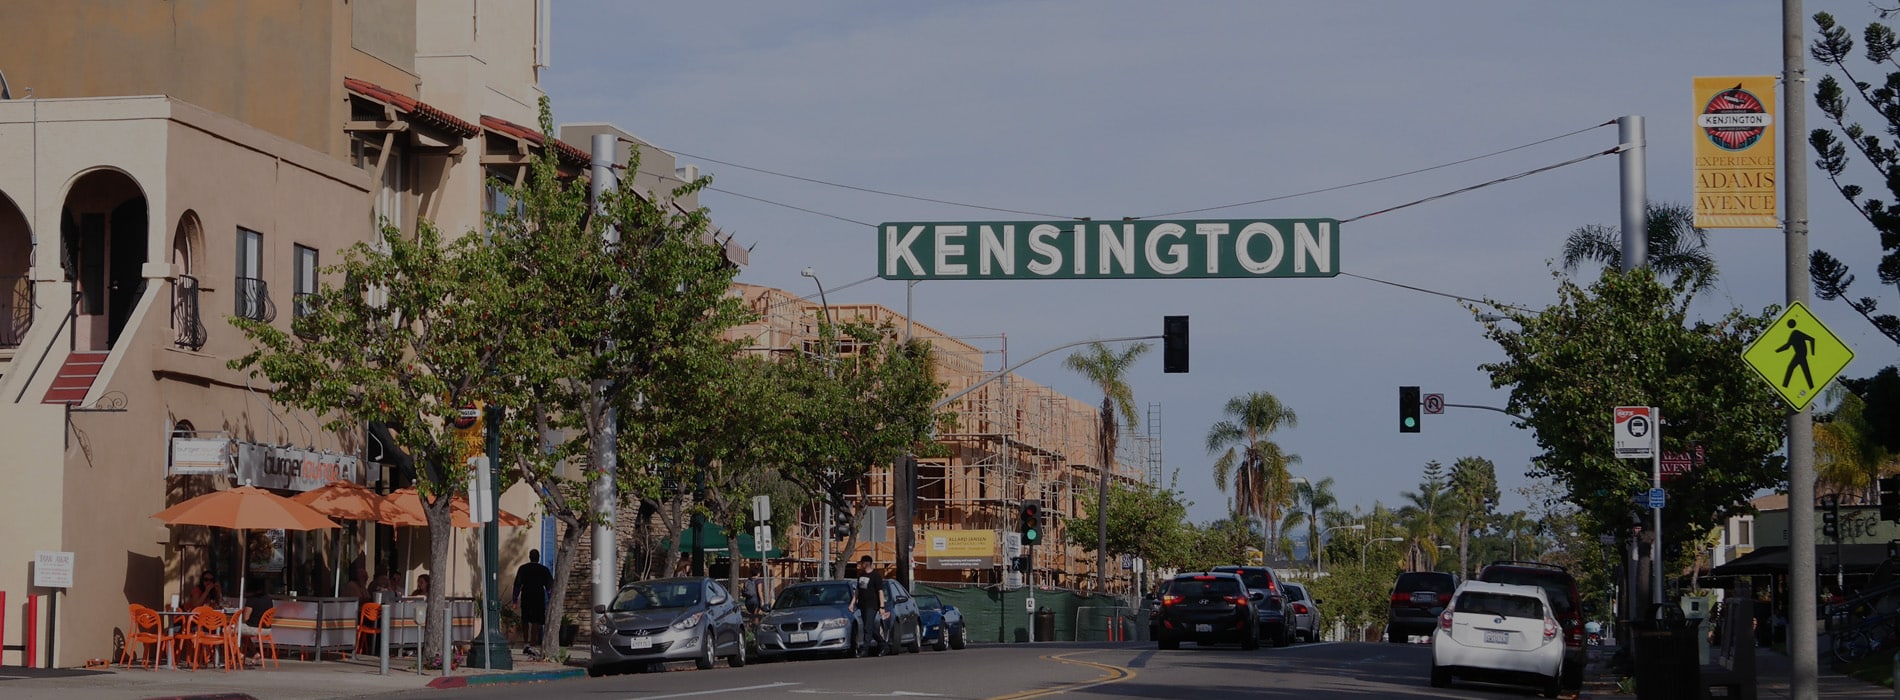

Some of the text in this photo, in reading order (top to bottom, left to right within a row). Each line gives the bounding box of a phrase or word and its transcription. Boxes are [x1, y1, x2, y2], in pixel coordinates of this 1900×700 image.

[1705, 115, 1763, 125] KENSINGTON
[1696, 156, 1774, 167] EXPERIENCE
[1696, 172, 1775, 189] ADAMS
[1696, 195, 1774, 210] AVENUE
[886, 222, 1331, 275] KENSINGTON
